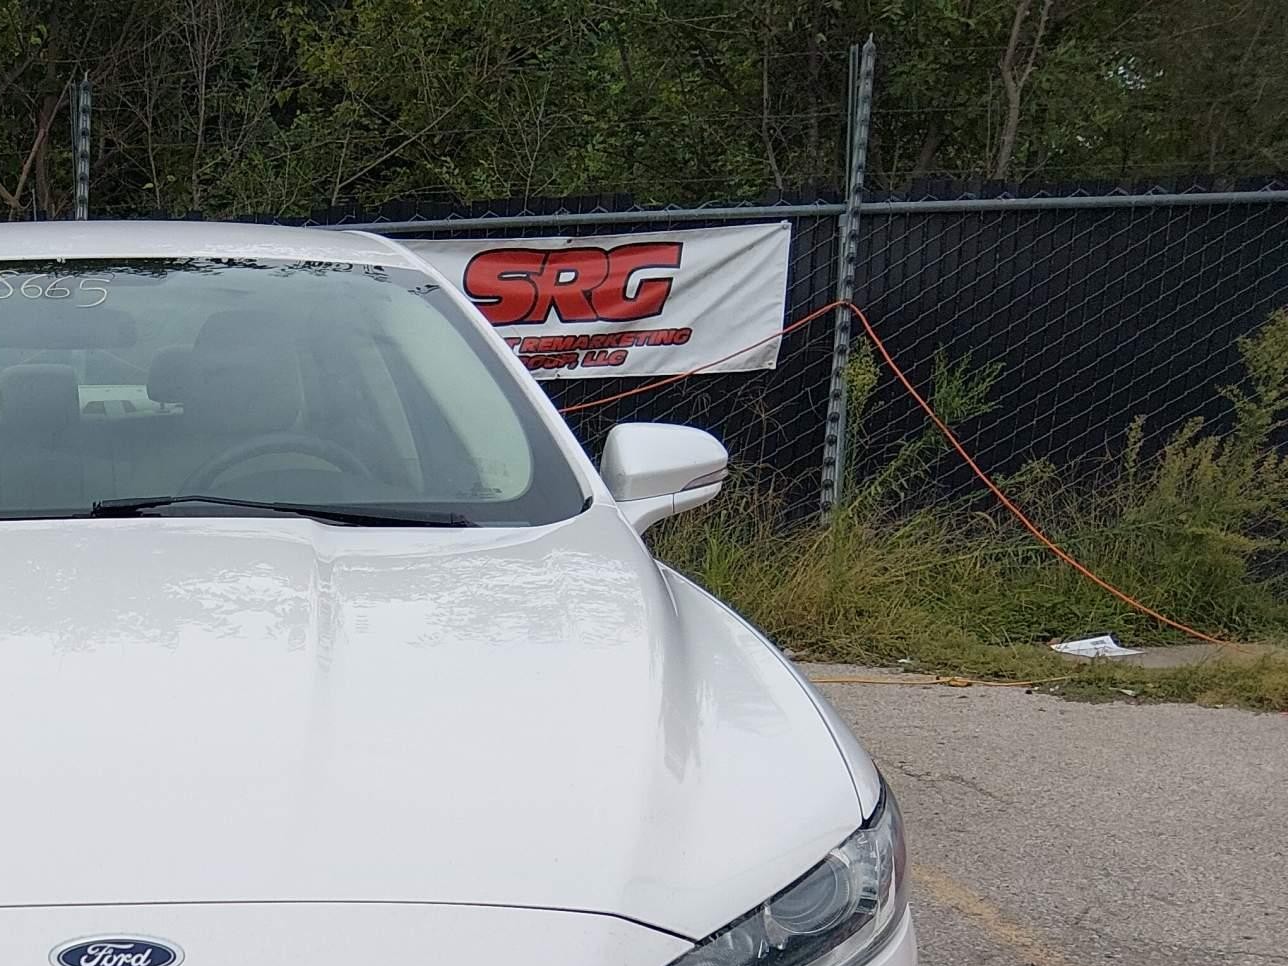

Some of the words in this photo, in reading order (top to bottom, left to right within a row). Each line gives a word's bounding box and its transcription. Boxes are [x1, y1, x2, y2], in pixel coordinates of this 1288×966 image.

[463, 242, 684, 325] SRG
[519, 328, 692, 353] REMARKETING
[581, 350, 629, 368] LLC
